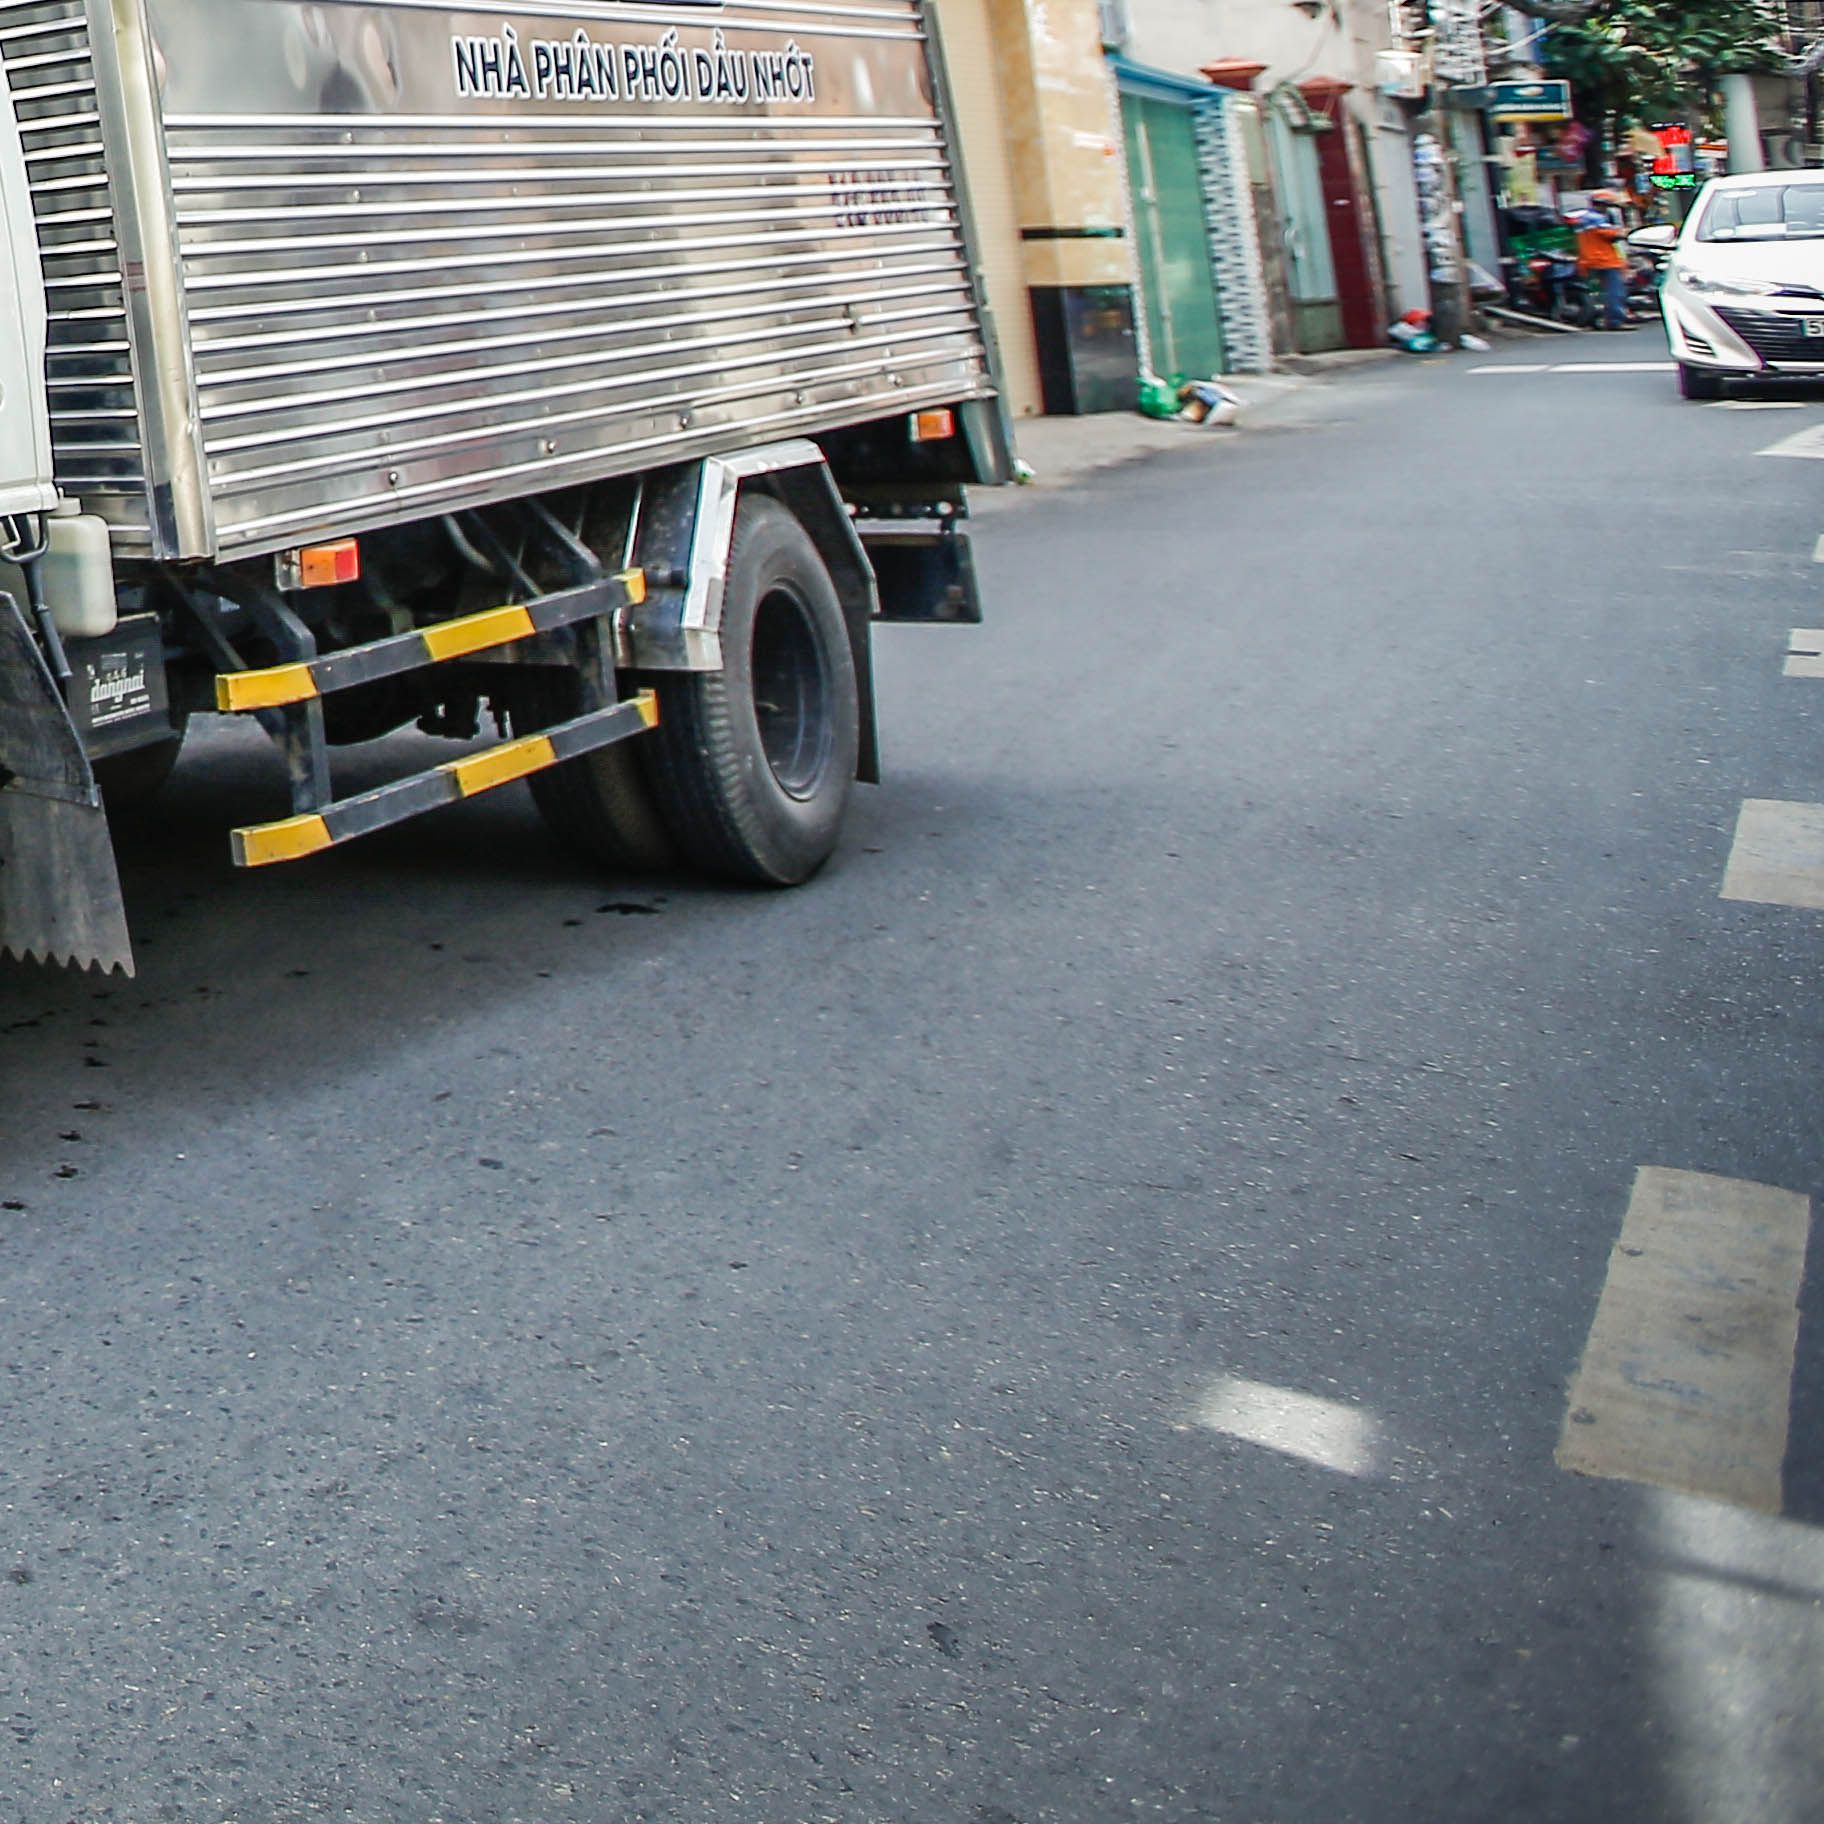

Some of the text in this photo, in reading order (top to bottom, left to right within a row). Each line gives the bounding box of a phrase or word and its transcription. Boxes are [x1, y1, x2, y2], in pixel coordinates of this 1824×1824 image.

[455, 25, 815, 101] NHÀ PHÂN PHỐI DẦU NHỚT
